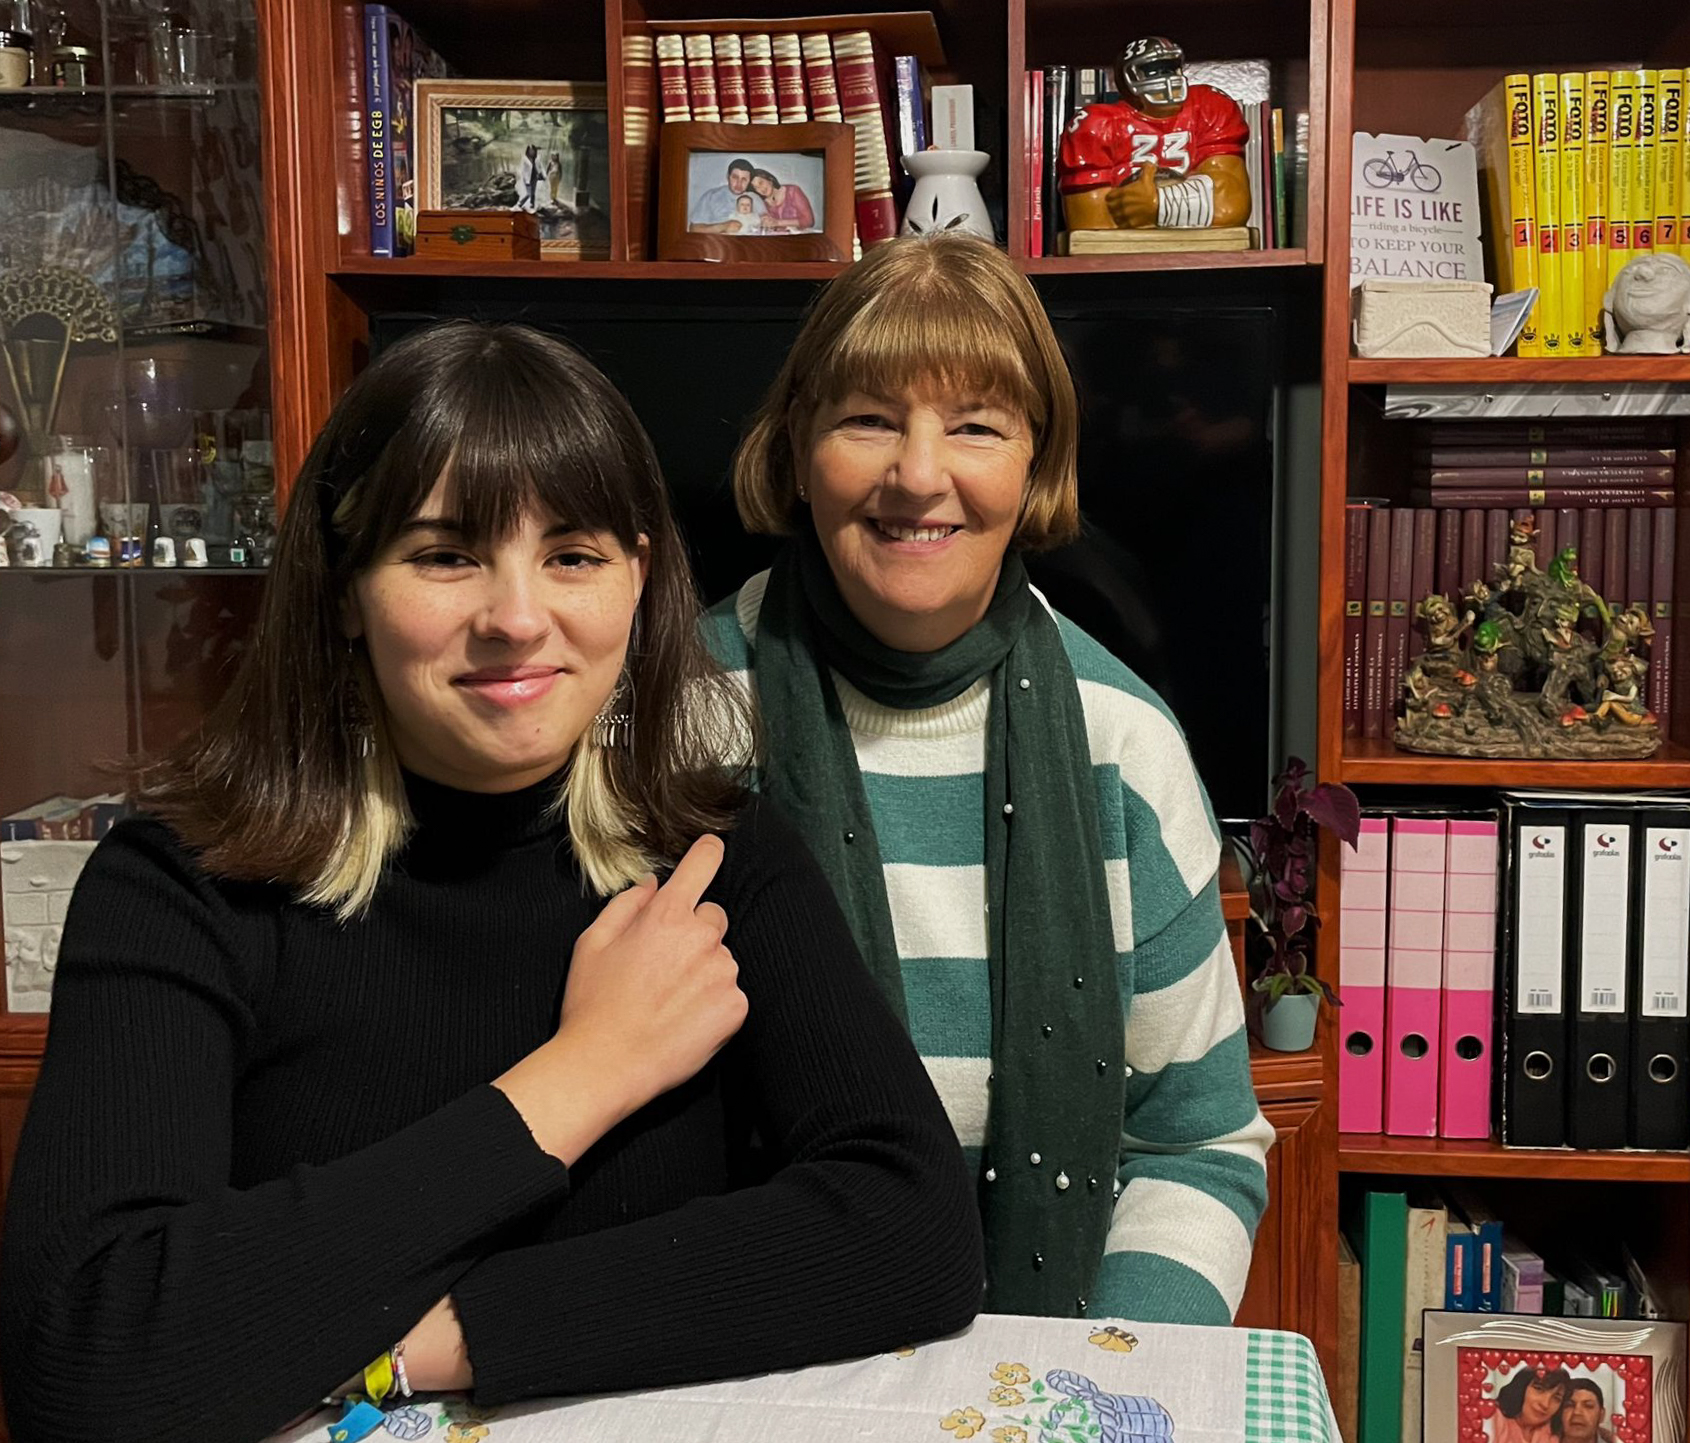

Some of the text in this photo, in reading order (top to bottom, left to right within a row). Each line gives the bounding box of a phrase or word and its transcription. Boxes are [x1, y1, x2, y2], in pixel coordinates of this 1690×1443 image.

[1124, 39, 1148, 60] 33
[1514, 93, 1529, 135] FOTO
[1545, 99, 1556, 142] FOTO
[1569, 97, 1582, 140] FOTO
[1594, 90, 1607, 132] FOTO
[1618, 94, 1632, 137] FOTO
[1640, 94, 1654, 136] FOTO
[1666, 89, 1680, 132] FOTO
[372, 110, 385, 226] LOS NIÑOS DE EGB
[1351, 196, 1462, 223] IFE IS LIKE
[1369, 222, 1399, 234] riding
[1410, 223, 1441, 235] bicycle
[1519, 229, 1528, 242] 1
[1569, 233, 1579, 247] 3
[1593, 227, 1603, 240] 4
[1616, 230, 1625, 243] 5
[1640, 230, 1650, 243] 6
[1663, 225, 1673, 238] 7
[1375, 238, 1416, 251] KEEP
[1420, 241, 1465, 255] YOUR
[1350, 256, 1467, 280] BALANCE
